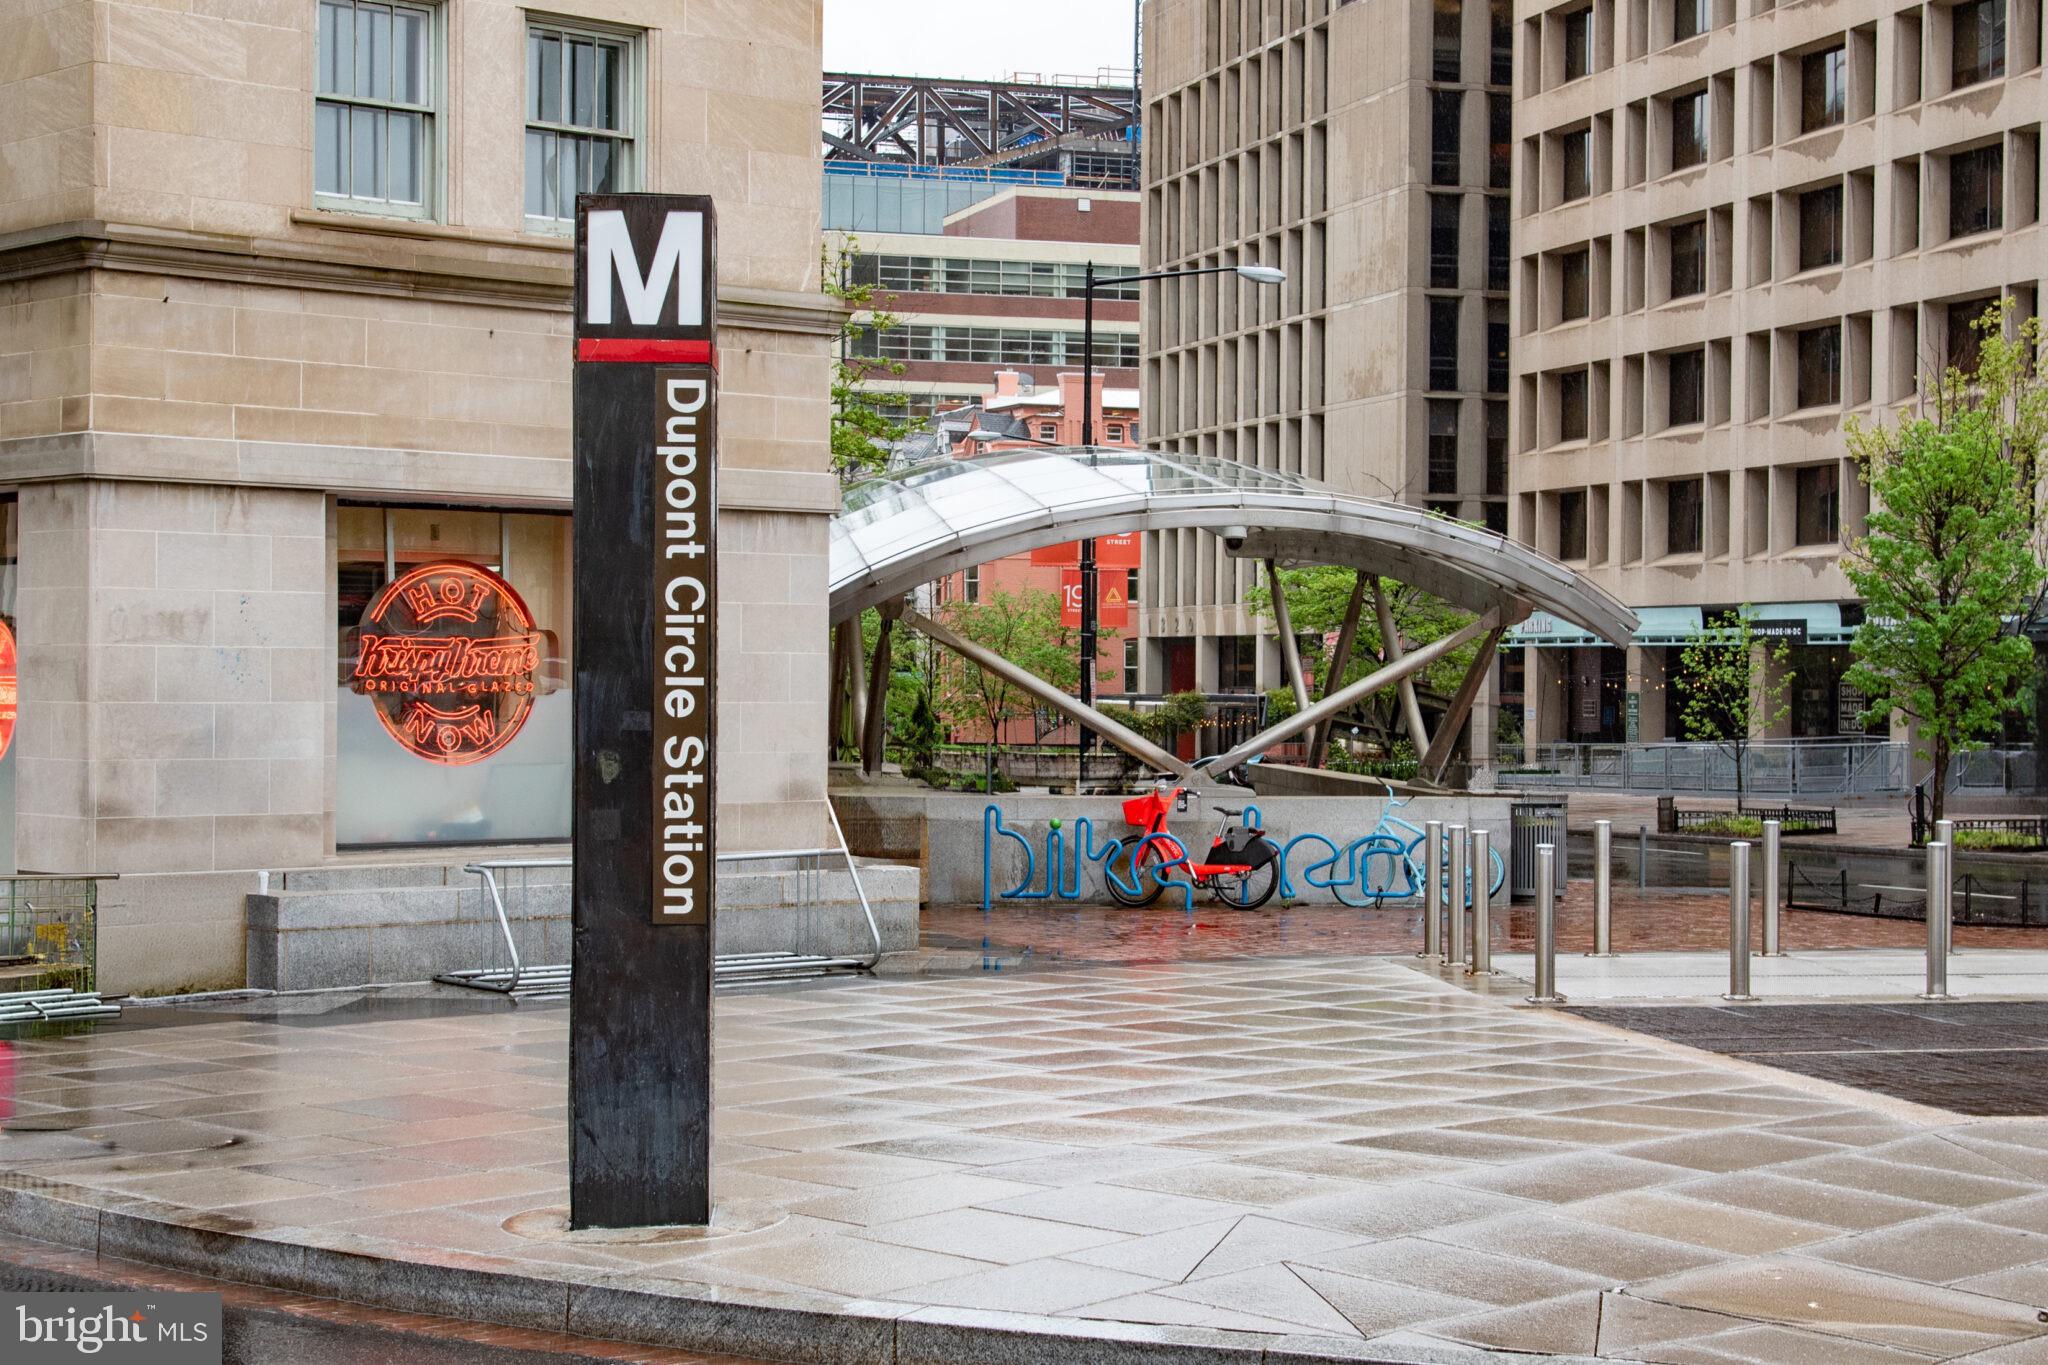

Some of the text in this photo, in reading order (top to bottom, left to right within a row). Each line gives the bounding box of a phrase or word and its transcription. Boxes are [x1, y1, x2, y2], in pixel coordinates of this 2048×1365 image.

[587, 210, 703, 326] M
[408, 576, 490, 614] HOT
[356, 632, 541, 683] Krispy Kreme
[656, 379, 707, 915] Dupont Circle Station
[365, 679, 535, 694] ORIGINAL GLAZED
[1841, 702, 1863, 712] MADE
[405, 709, 496, 752] NOW
